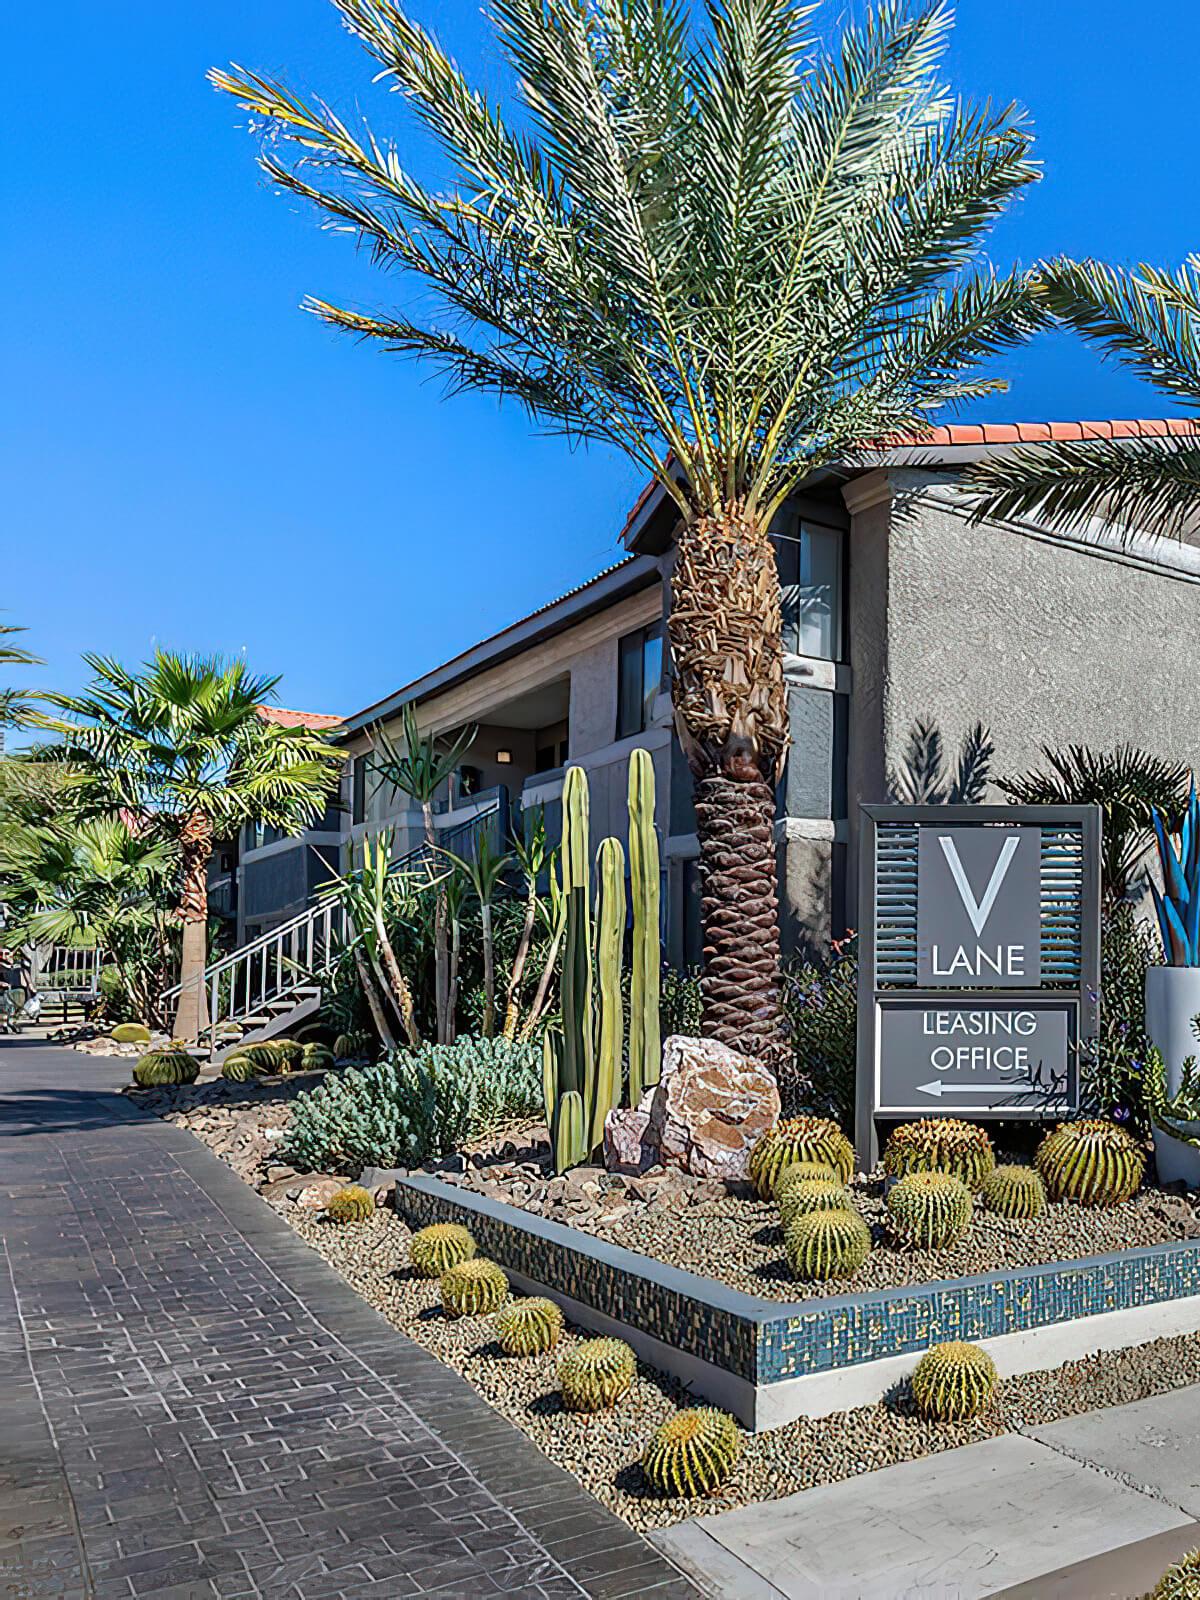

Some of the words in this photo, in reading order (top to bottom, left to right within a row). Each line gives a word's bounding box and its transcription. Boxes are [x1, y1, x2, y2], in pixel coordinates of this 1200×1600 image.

[937, 836, 1021, 938] V
[932, 945, 1025, 976] LANE
[922, 1011, 1037, 1036] LEASING
[930, 1046, 1029, 1071] OFFICE
